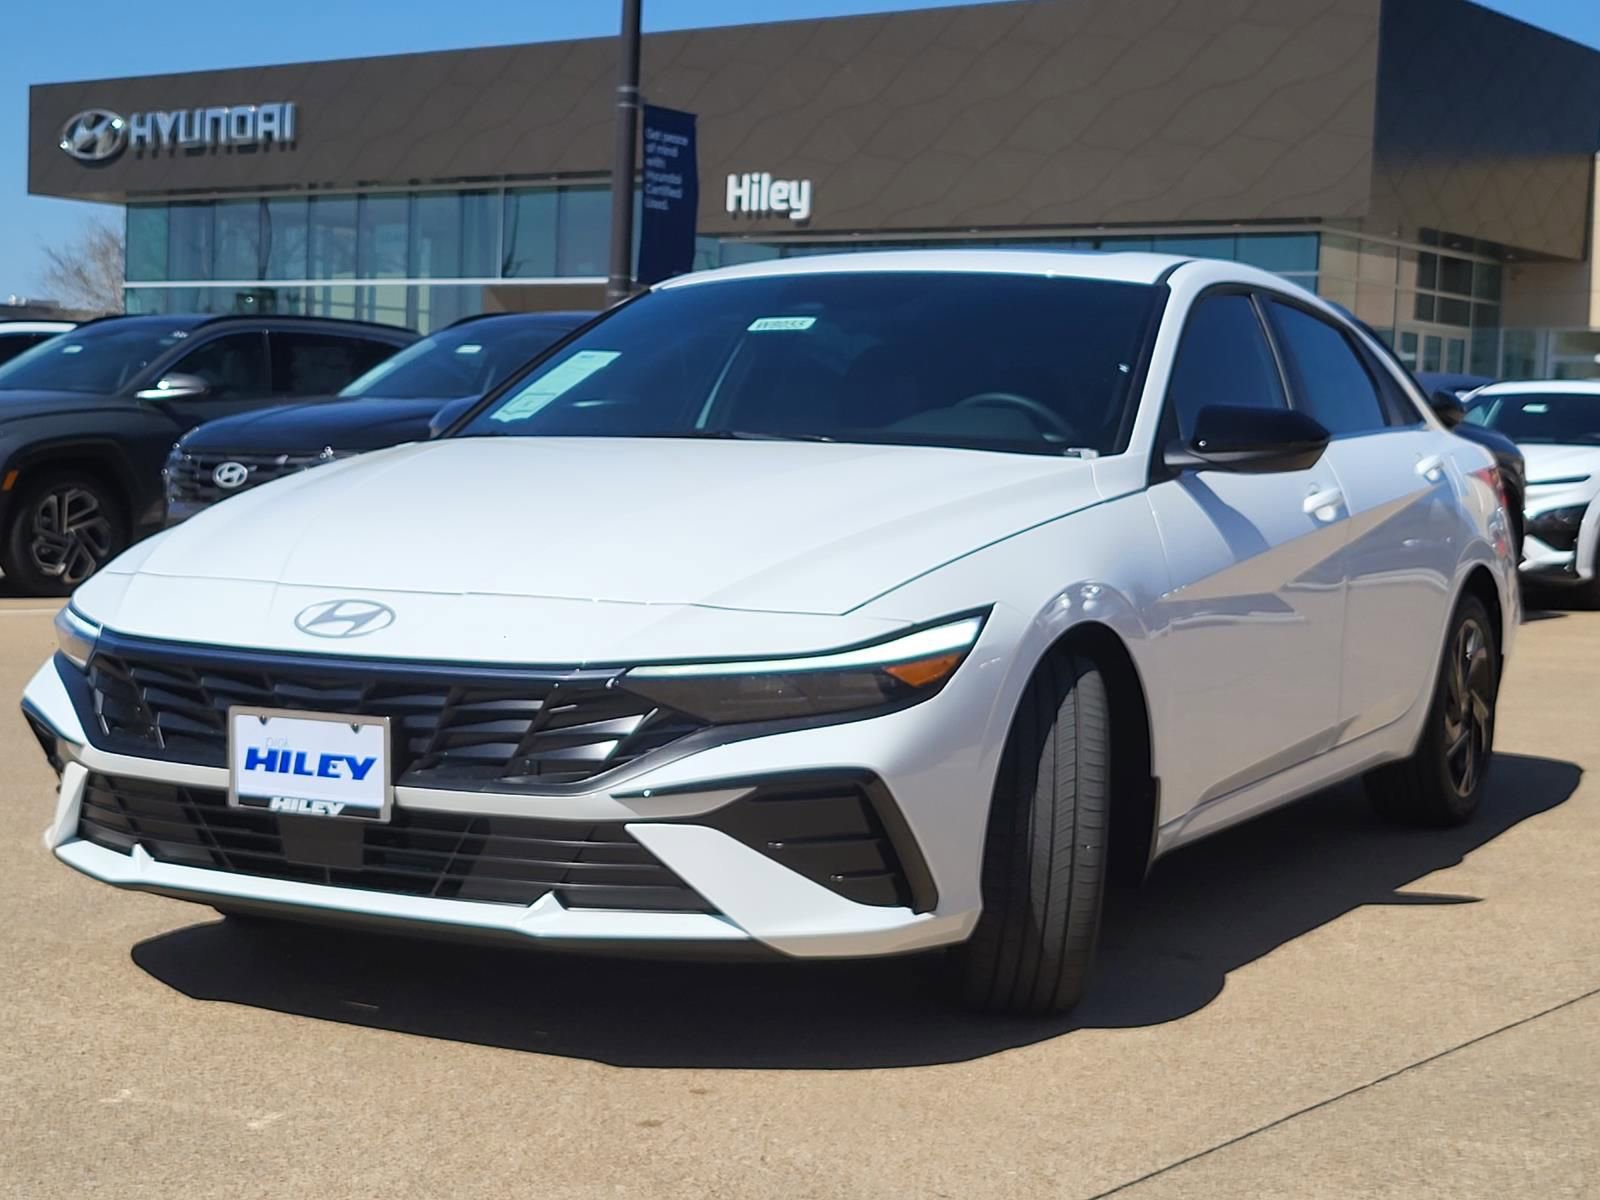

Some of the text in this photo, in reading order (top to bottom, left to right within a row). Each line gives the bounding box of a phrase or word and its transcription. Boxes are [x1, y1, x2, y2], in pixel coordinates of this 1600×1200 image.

[130, 102, 296, 147] HYUNDAI
[726, 172, 811, 219] Hiley
[244, 747, 377, 781] HILEY
[269, 796, 345, 816] HILEY
